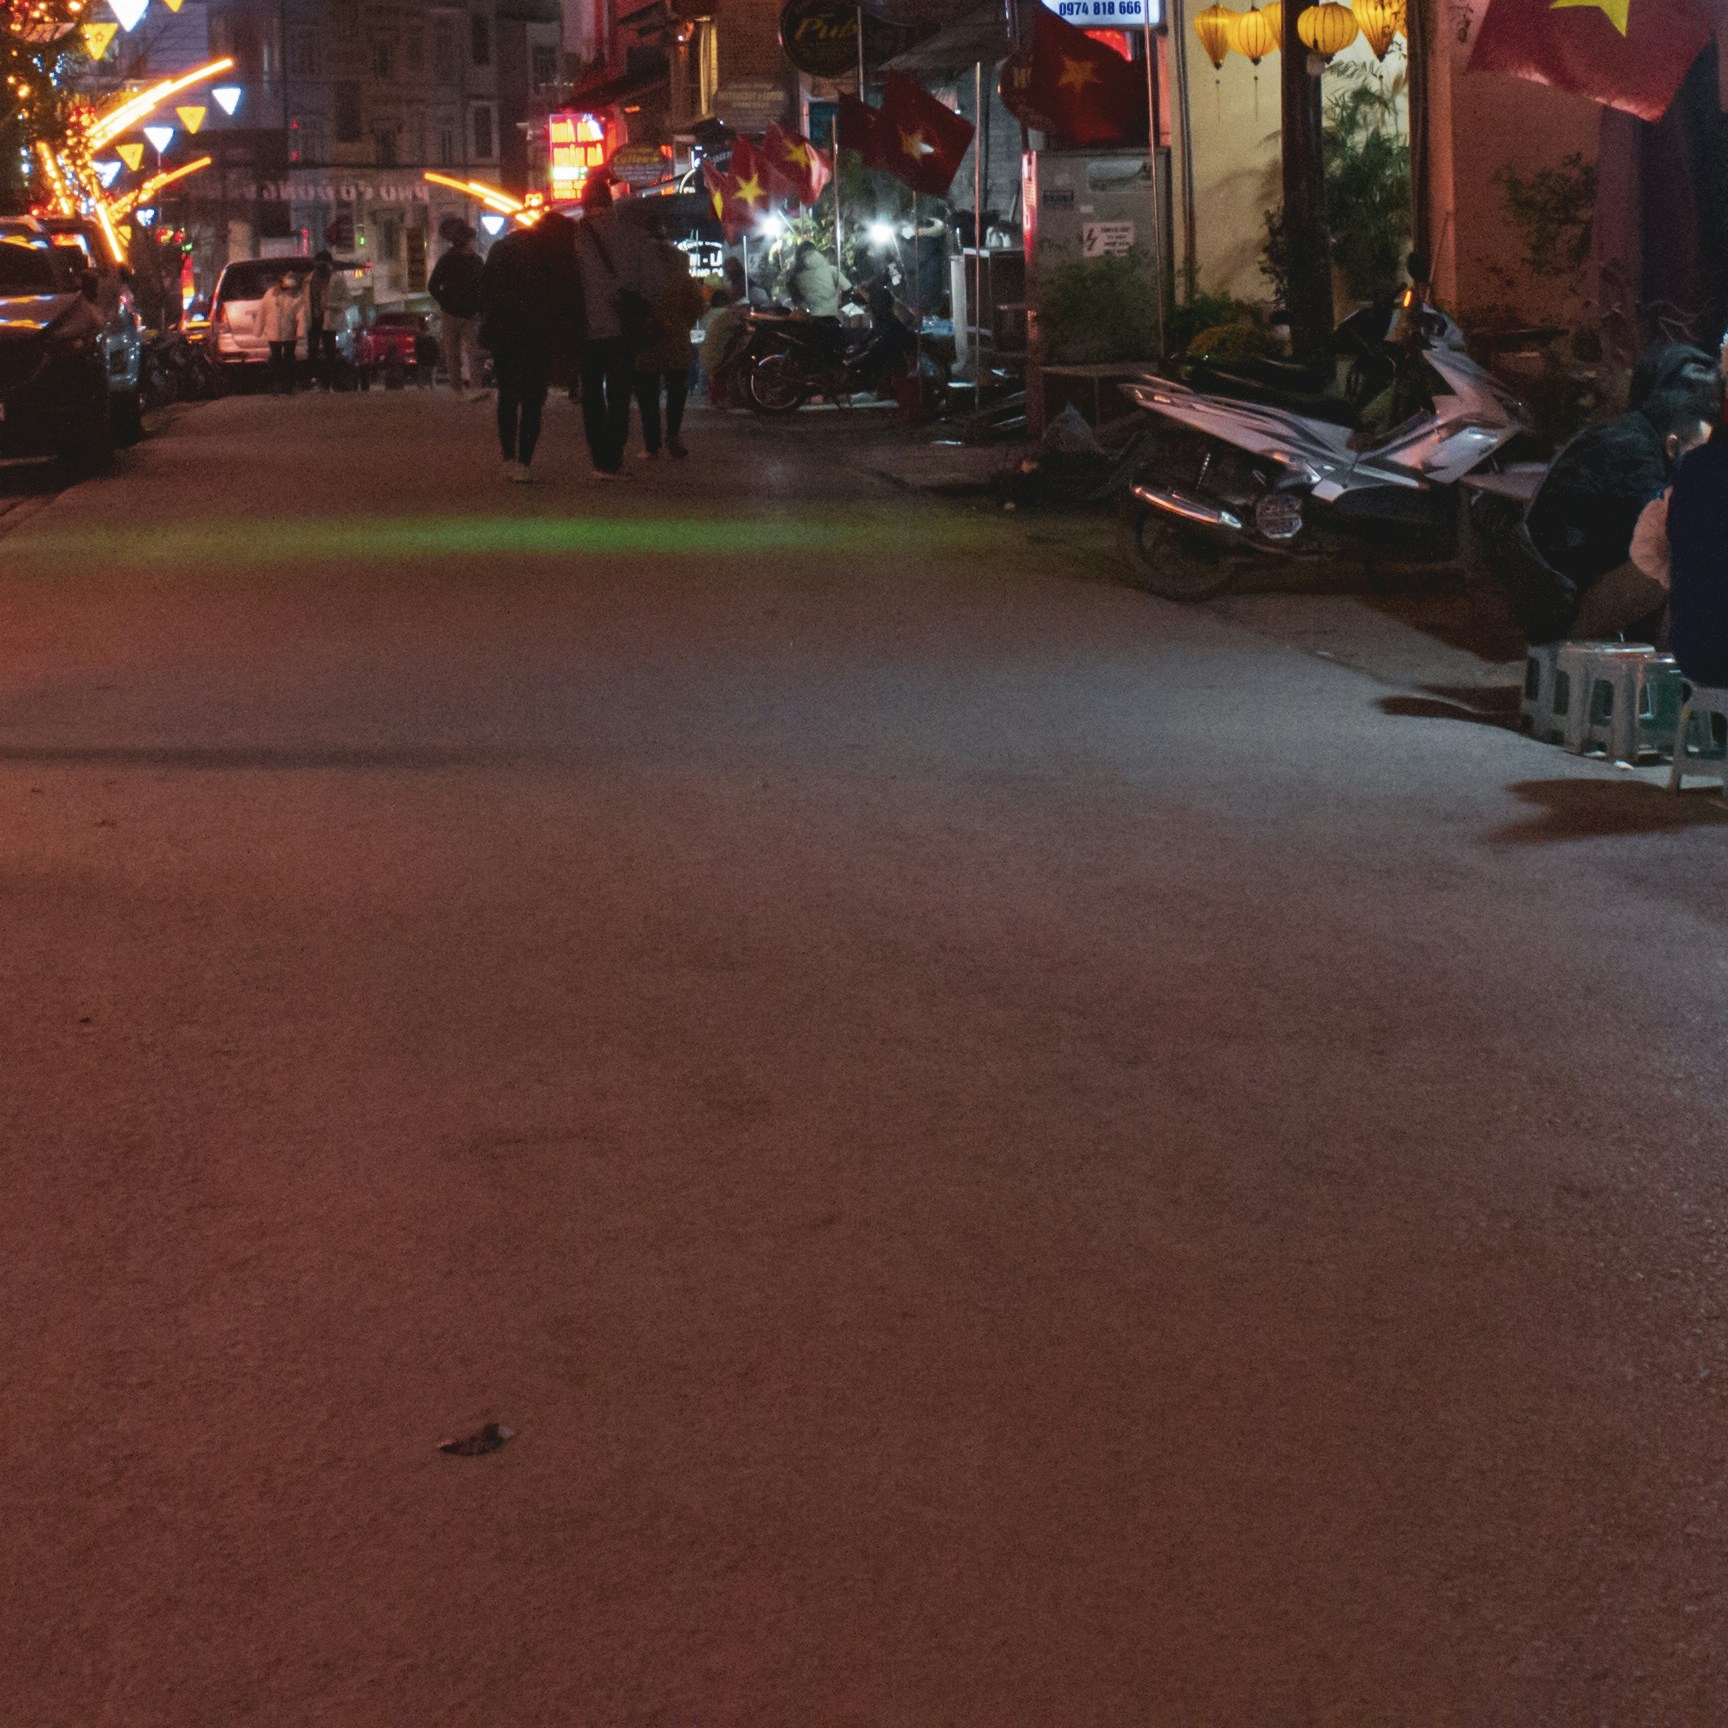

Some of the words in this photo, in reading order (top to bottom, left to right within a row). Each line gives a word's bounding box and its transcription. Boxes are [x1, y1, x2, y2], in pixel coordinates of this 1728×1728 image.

[1058, 1, 1089, 16] 0974
[1093, 0, 1115, 15] 818
[1118, 0, 1142, 15] 666
